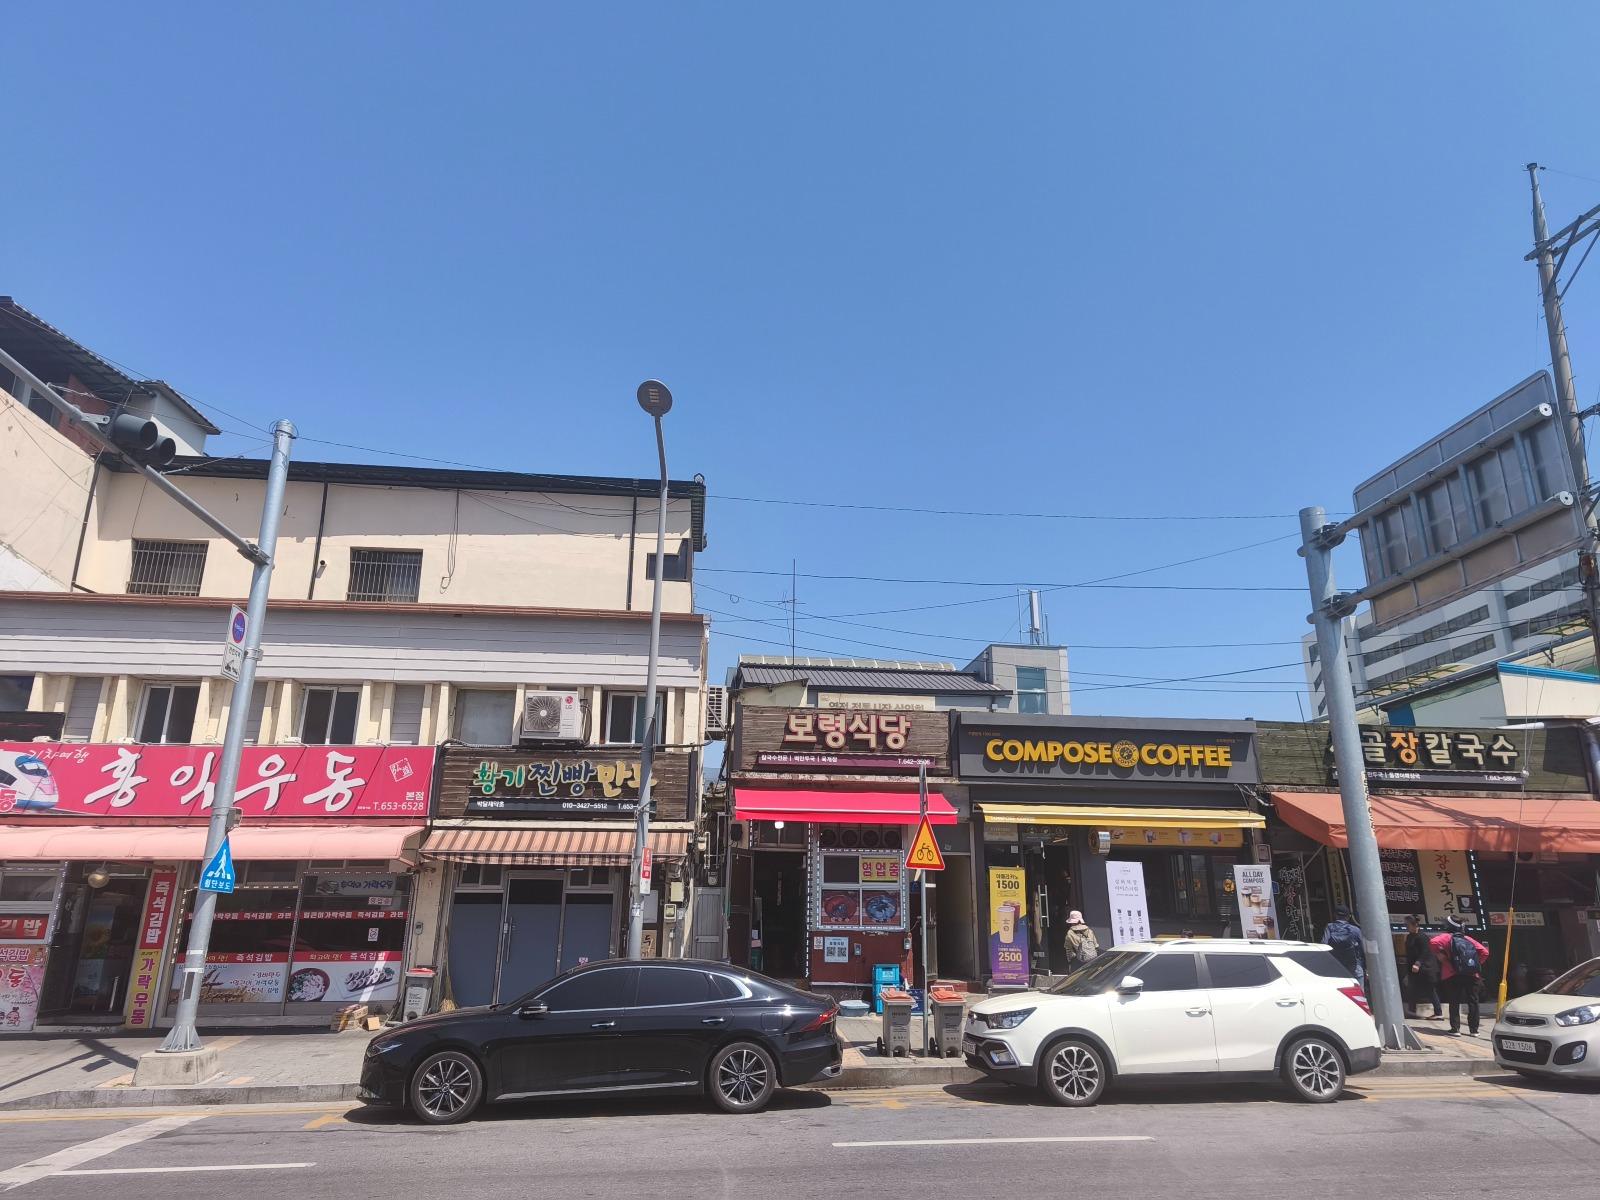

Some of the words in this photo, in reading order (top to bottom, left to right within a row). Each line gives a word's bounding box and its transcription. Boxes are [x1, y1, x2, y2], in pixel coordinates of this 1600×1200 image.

[785, 713, 912, 749] 보령식당
[986, 738, 1112, 763] COMPOSE
[1140, 742, 1232, 767] COFFEE
[1330, 731, 1518, 765] 골장칼국수
[405, 791, 424, 801] 본점
[372, 802, 424, 811] T.653-6528
[204, 879, 231, 890] 횡단보도
[996, 880, 1020, 889] 1500
[146, 881, 169, 944] 즉석김밥
[235, 953, 273, 962] 즉석김밥
[350, 952, 386, 961] 즉석김밥
[998, 952, 1022, 962] 2500
[131, 958, 155, 1025] 가락우동
